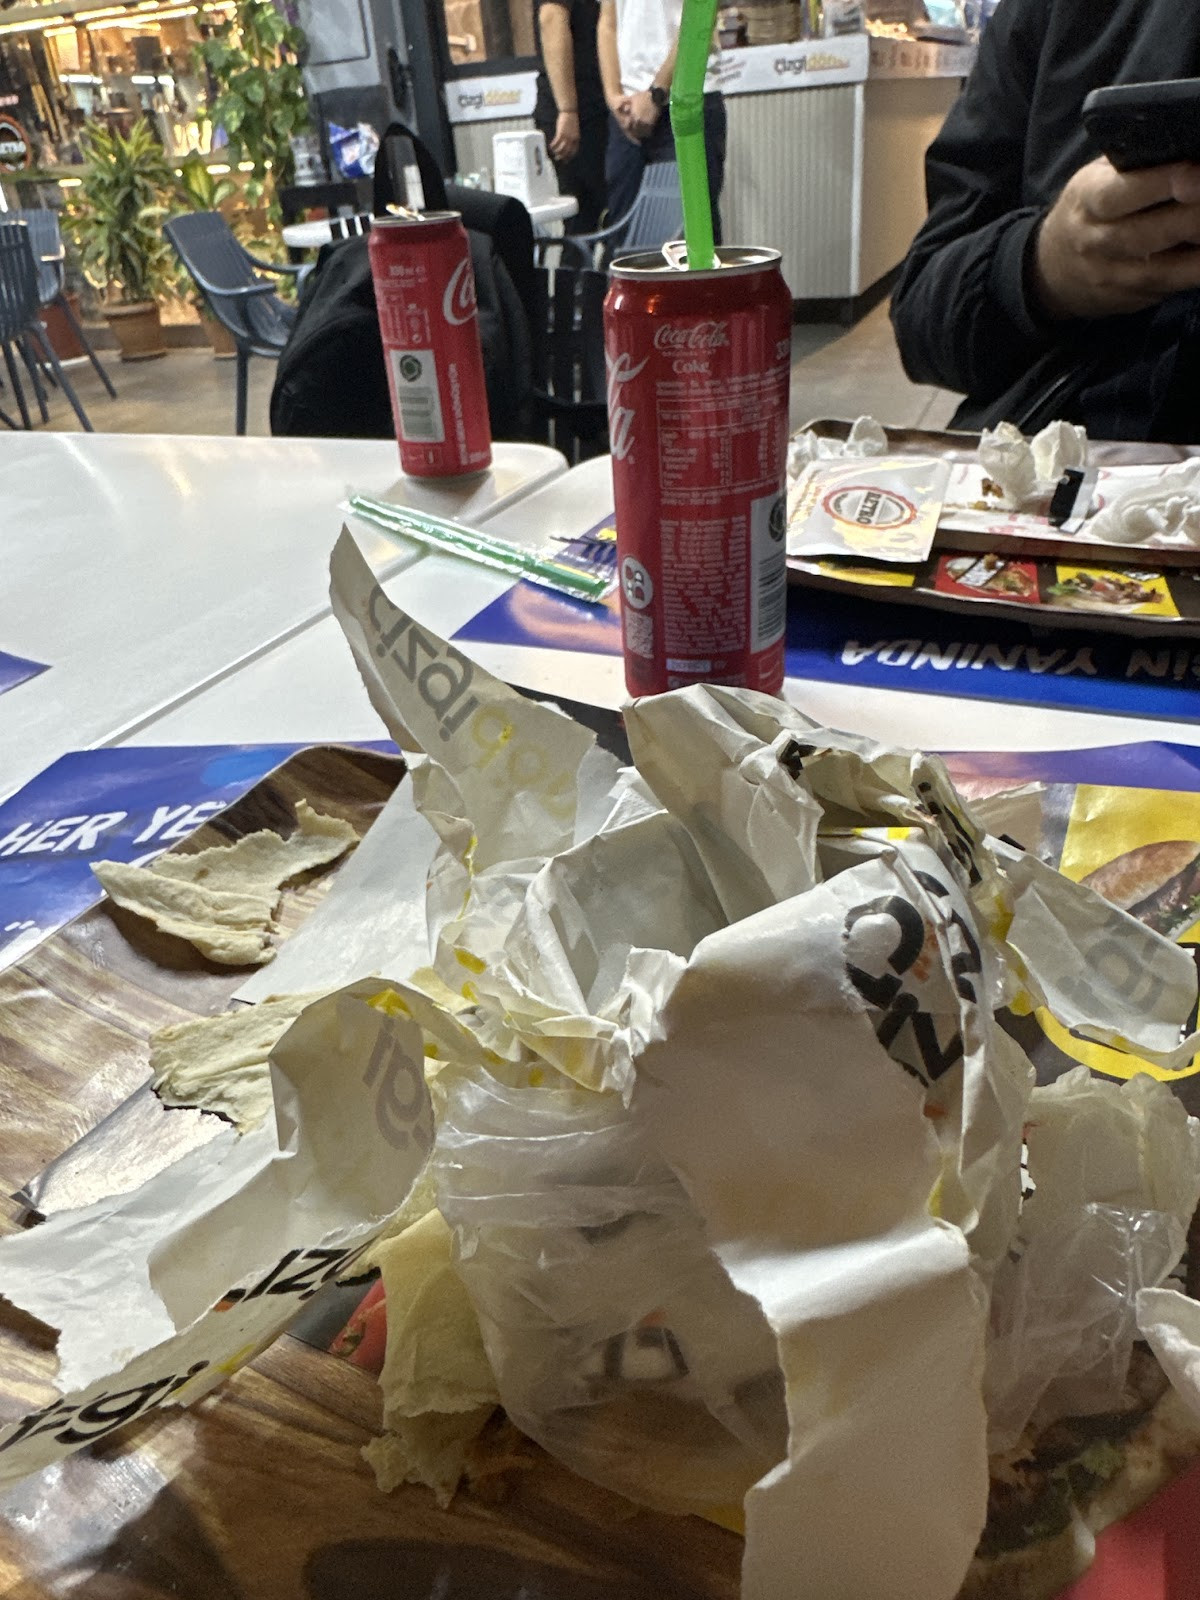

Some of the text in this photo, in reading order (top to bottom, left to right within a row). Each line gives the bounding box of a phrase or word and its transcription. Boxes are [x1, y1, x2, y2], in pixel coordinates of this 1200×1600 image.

[840, 638, 1098, 675] YANINDA
[0, 800, 228, 857] HER YE
